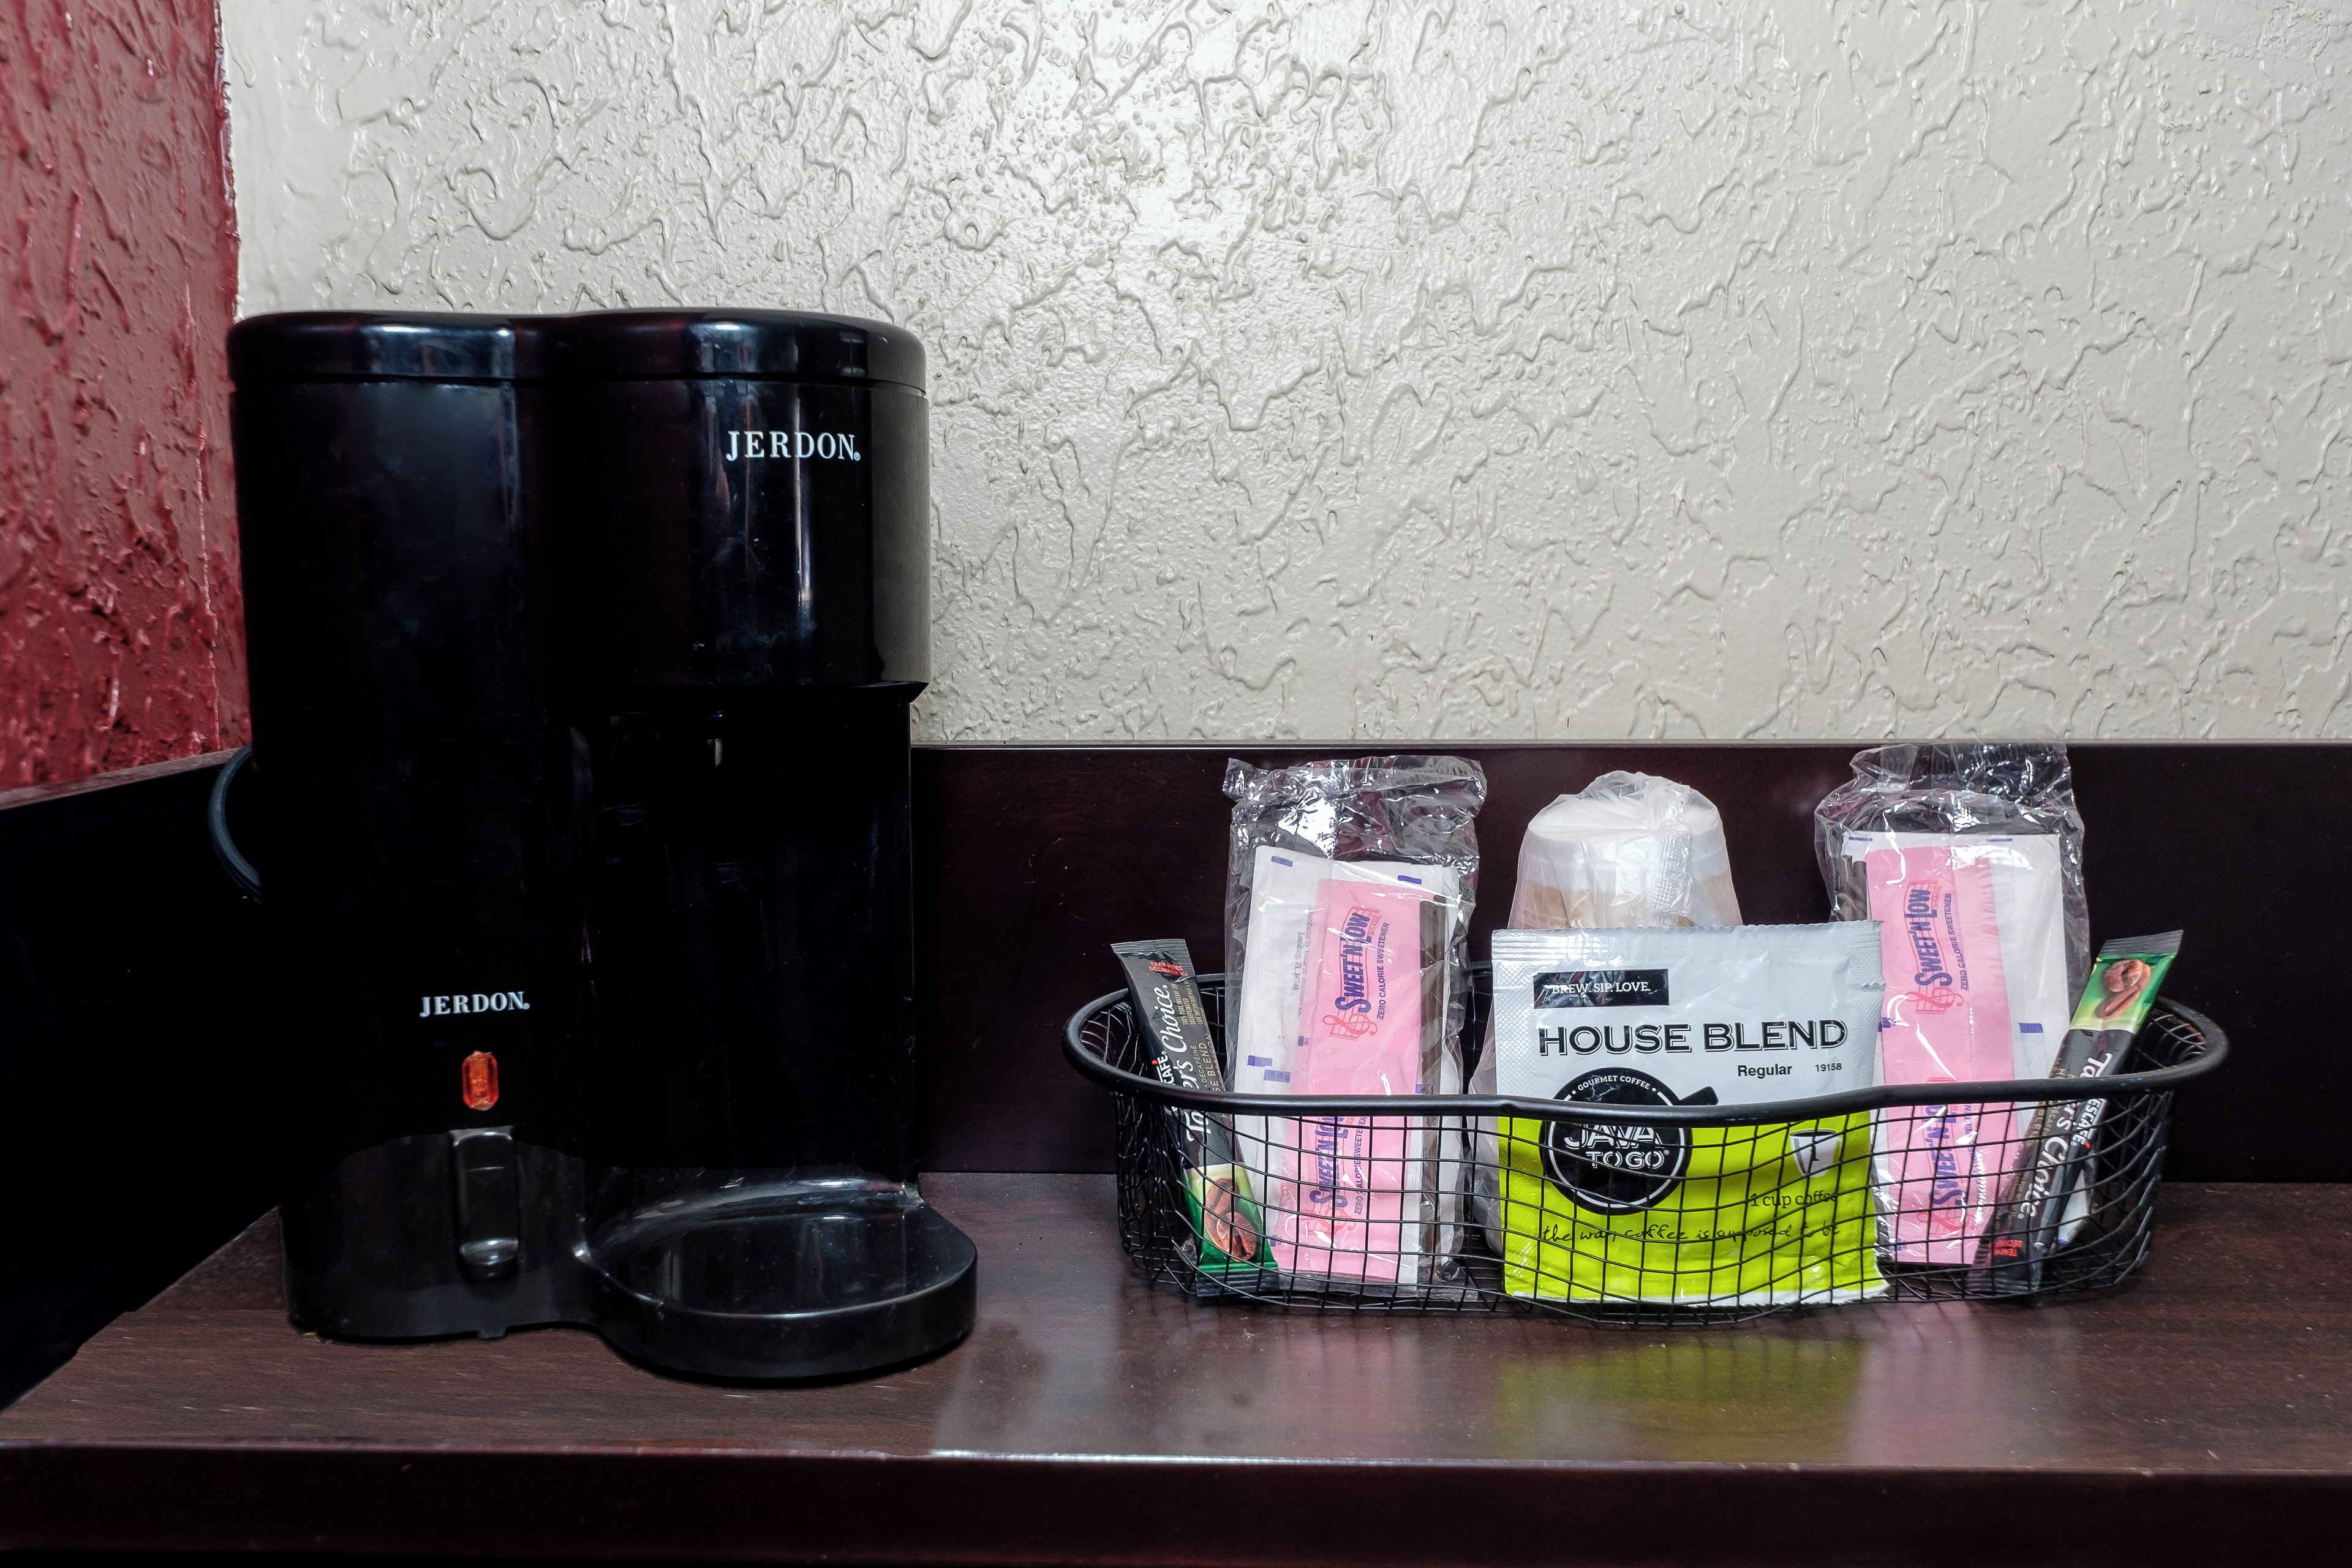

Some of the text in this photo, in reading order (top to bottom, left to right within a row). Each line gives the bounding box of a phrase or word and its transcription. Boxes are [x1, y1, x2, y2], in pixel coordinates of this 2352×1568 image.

[726, 431, 856, 461] JERDON
[1904, 889, 1937, 918] LOW
[1944, 893, 1955, 935] SWEETENER
[1340, 912, 1372, 943] LOW
[1950, 937, 1966, 968] CALORIE
[1377, 922, 1390, 1020] ZERO CALORIE SWEETENER
[1593, 982, 1613, 993] SIP.
[1616, 982, 1651, 992] LOVE.
[419, 992, 525, 1018] JERDON
[1154, 987, 1188, 1053] Choice
[1539, 1020, 1847, 1056] HOUSE BLEND
[1199, 1042, 1216, 1077] BLEND
[1738, 1063, 1842, 1079] Regular 19158
[1577, 1076, 1651, 1091] GOURMET COFFEE
[1354, 1117, 1368, 1159] SWEETEER
[1564, 1124, 1665, 1150] JAVA
[1585, 1151, 1664, 1170] TO GO
[1354, 1196, 1363, 1215] ZERO
[1763, 1195, 1792, 1209] cup
[1543, 1224, 1572, 1242] the
[1624, 1224, 1689, 1240] coffee
